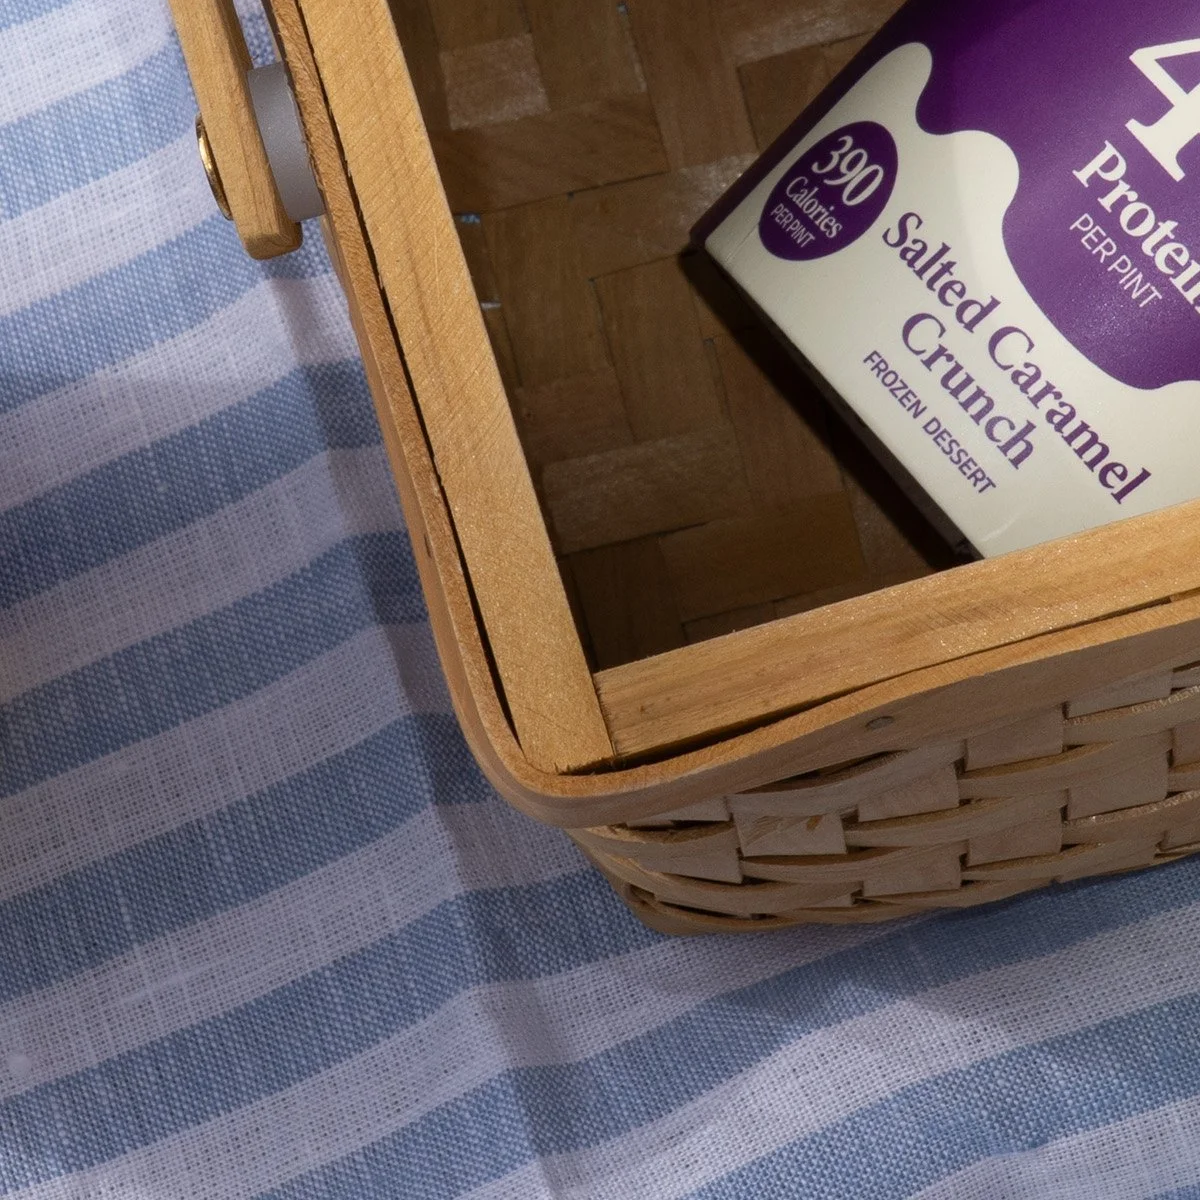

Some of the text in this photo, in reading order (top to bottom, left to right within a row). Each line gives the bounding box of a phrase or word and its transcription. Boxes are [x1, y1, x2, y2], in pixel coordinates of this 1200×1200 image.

[785, 176, 843, 239] Calories
[811, 135, 885, 207] 390
[769, 202, 816, 249] PER PINT
[1069, 212, 1163, 308] PER PINT
[881, 211, 1152, 505] Salted Caramel
[901, 312, 1038, 471] Crunch
[862, 349, 998, 494] FROZEN DESSERT
